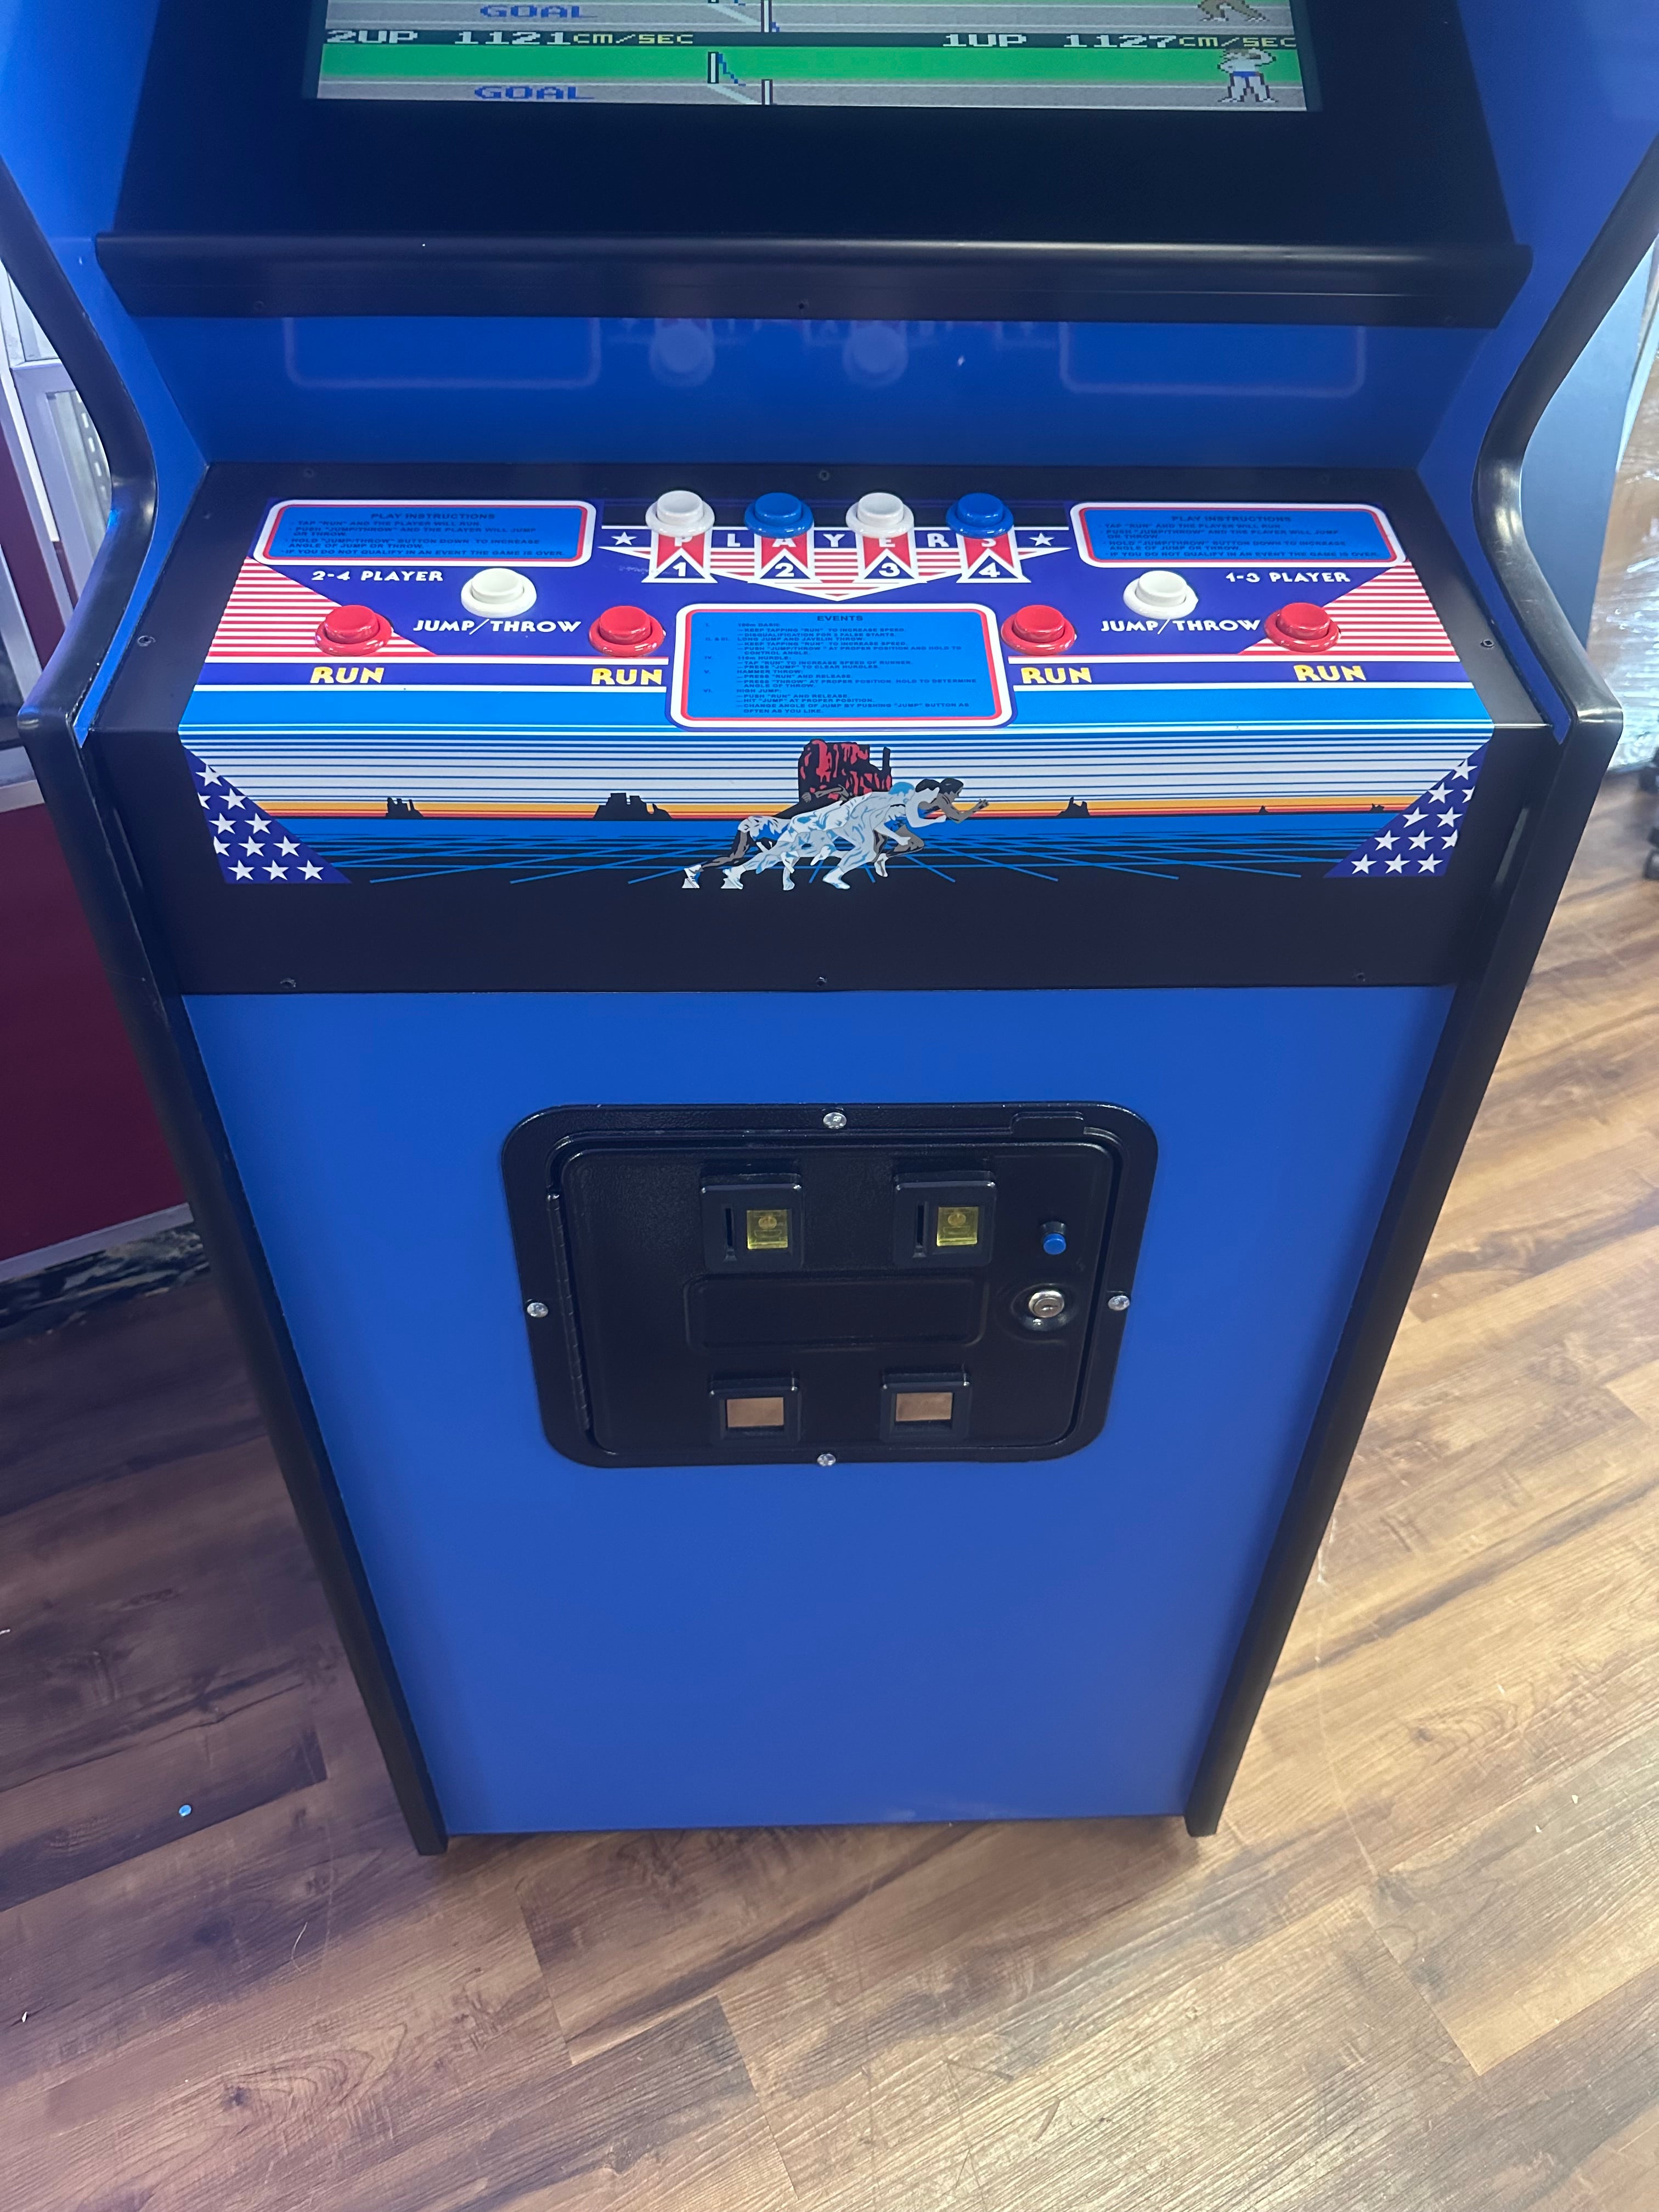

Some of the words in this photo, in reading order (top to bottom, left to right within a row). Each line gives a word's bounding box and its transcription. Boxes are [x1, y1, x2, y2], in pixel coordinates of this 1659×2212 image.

[480, 5, 597, 18] GOAL
[326, 30, 418, 44] 2UP
[943, 33, 1027, 47] 1UP
[475, 85, 595, 100] GOAL
[312, 571, 351, 581] 2-4
[361, 571, 443, 582] PLAYER
[673, 562, 686, 577] 1
[775, 562, 794, 577] 2
[879, 562, 900, 577] 3
[978, 562, 1000, 578] 4
[1225, 572, 1261, 583] 1-3
[1269, 572, 1351, 583] PLAYER
[413, 618, 582, 635] JUMP/THROW
[1101, 618, 1261, 635] JUMP/THROW
[310, 667, 385, 684] RUN
[590, 668, 662, 685] RUN
[1021, 667, 1093, 684] RUN
[1294, 665, 1366, 682] RUN
